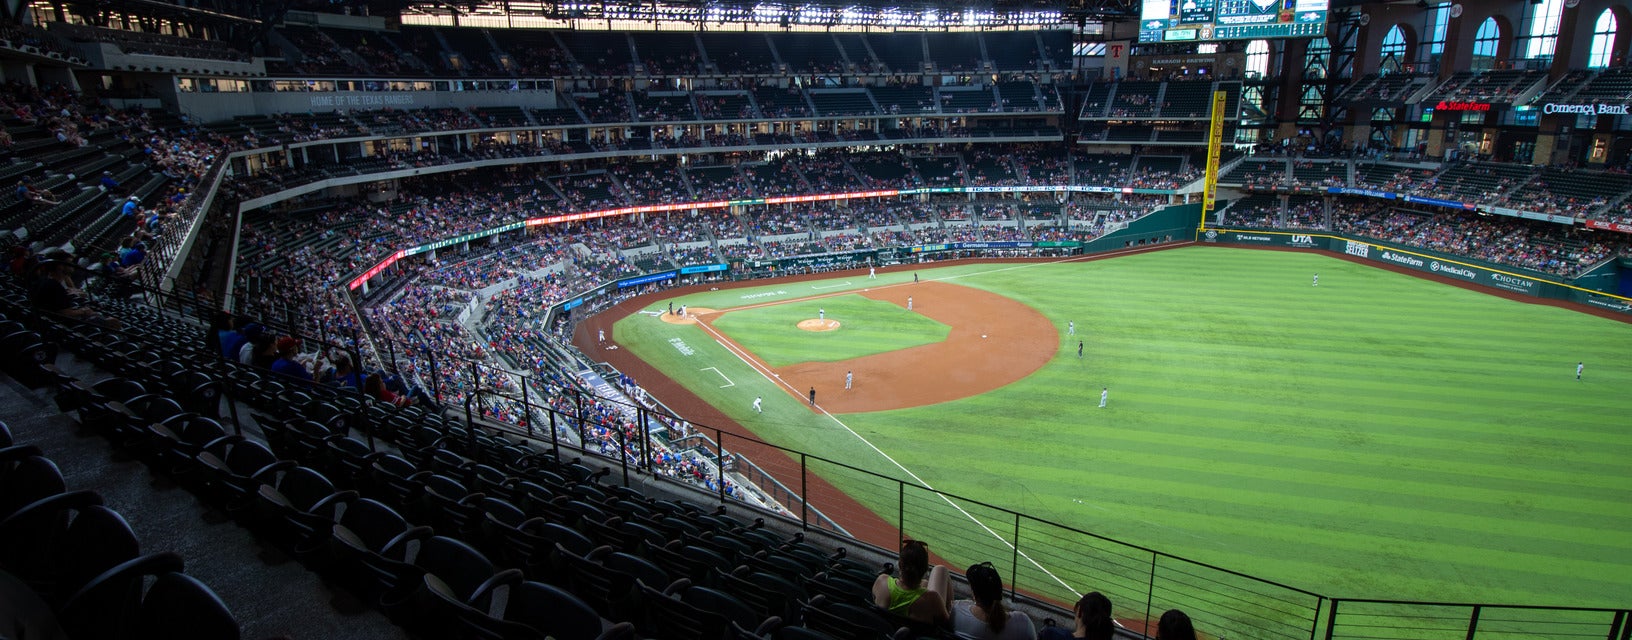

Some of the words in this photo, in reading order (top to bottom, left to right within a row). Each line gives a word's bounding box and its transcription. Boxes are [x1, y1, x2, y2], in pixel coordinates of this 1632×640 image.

[1111, 44, 1123, 58] T
[310, 96, 333, 106] HOME
[335, 96, 345, 106] OF
[346, 95, 360, 105] THE
[361, 95, 383, 105] TEXAS
[384, 94, 414, 105] RANGERS
[1597, 103, 1630, 115] Bank
[1291, 235, 1313, 244] UTA
[1345, 244, 1368, 258] SELTZER
[1439, 264, 1463, 276] Medical
[1463, 269, 1477, 280] City
[1495, 273, 1534, 288] CHOCTAW
